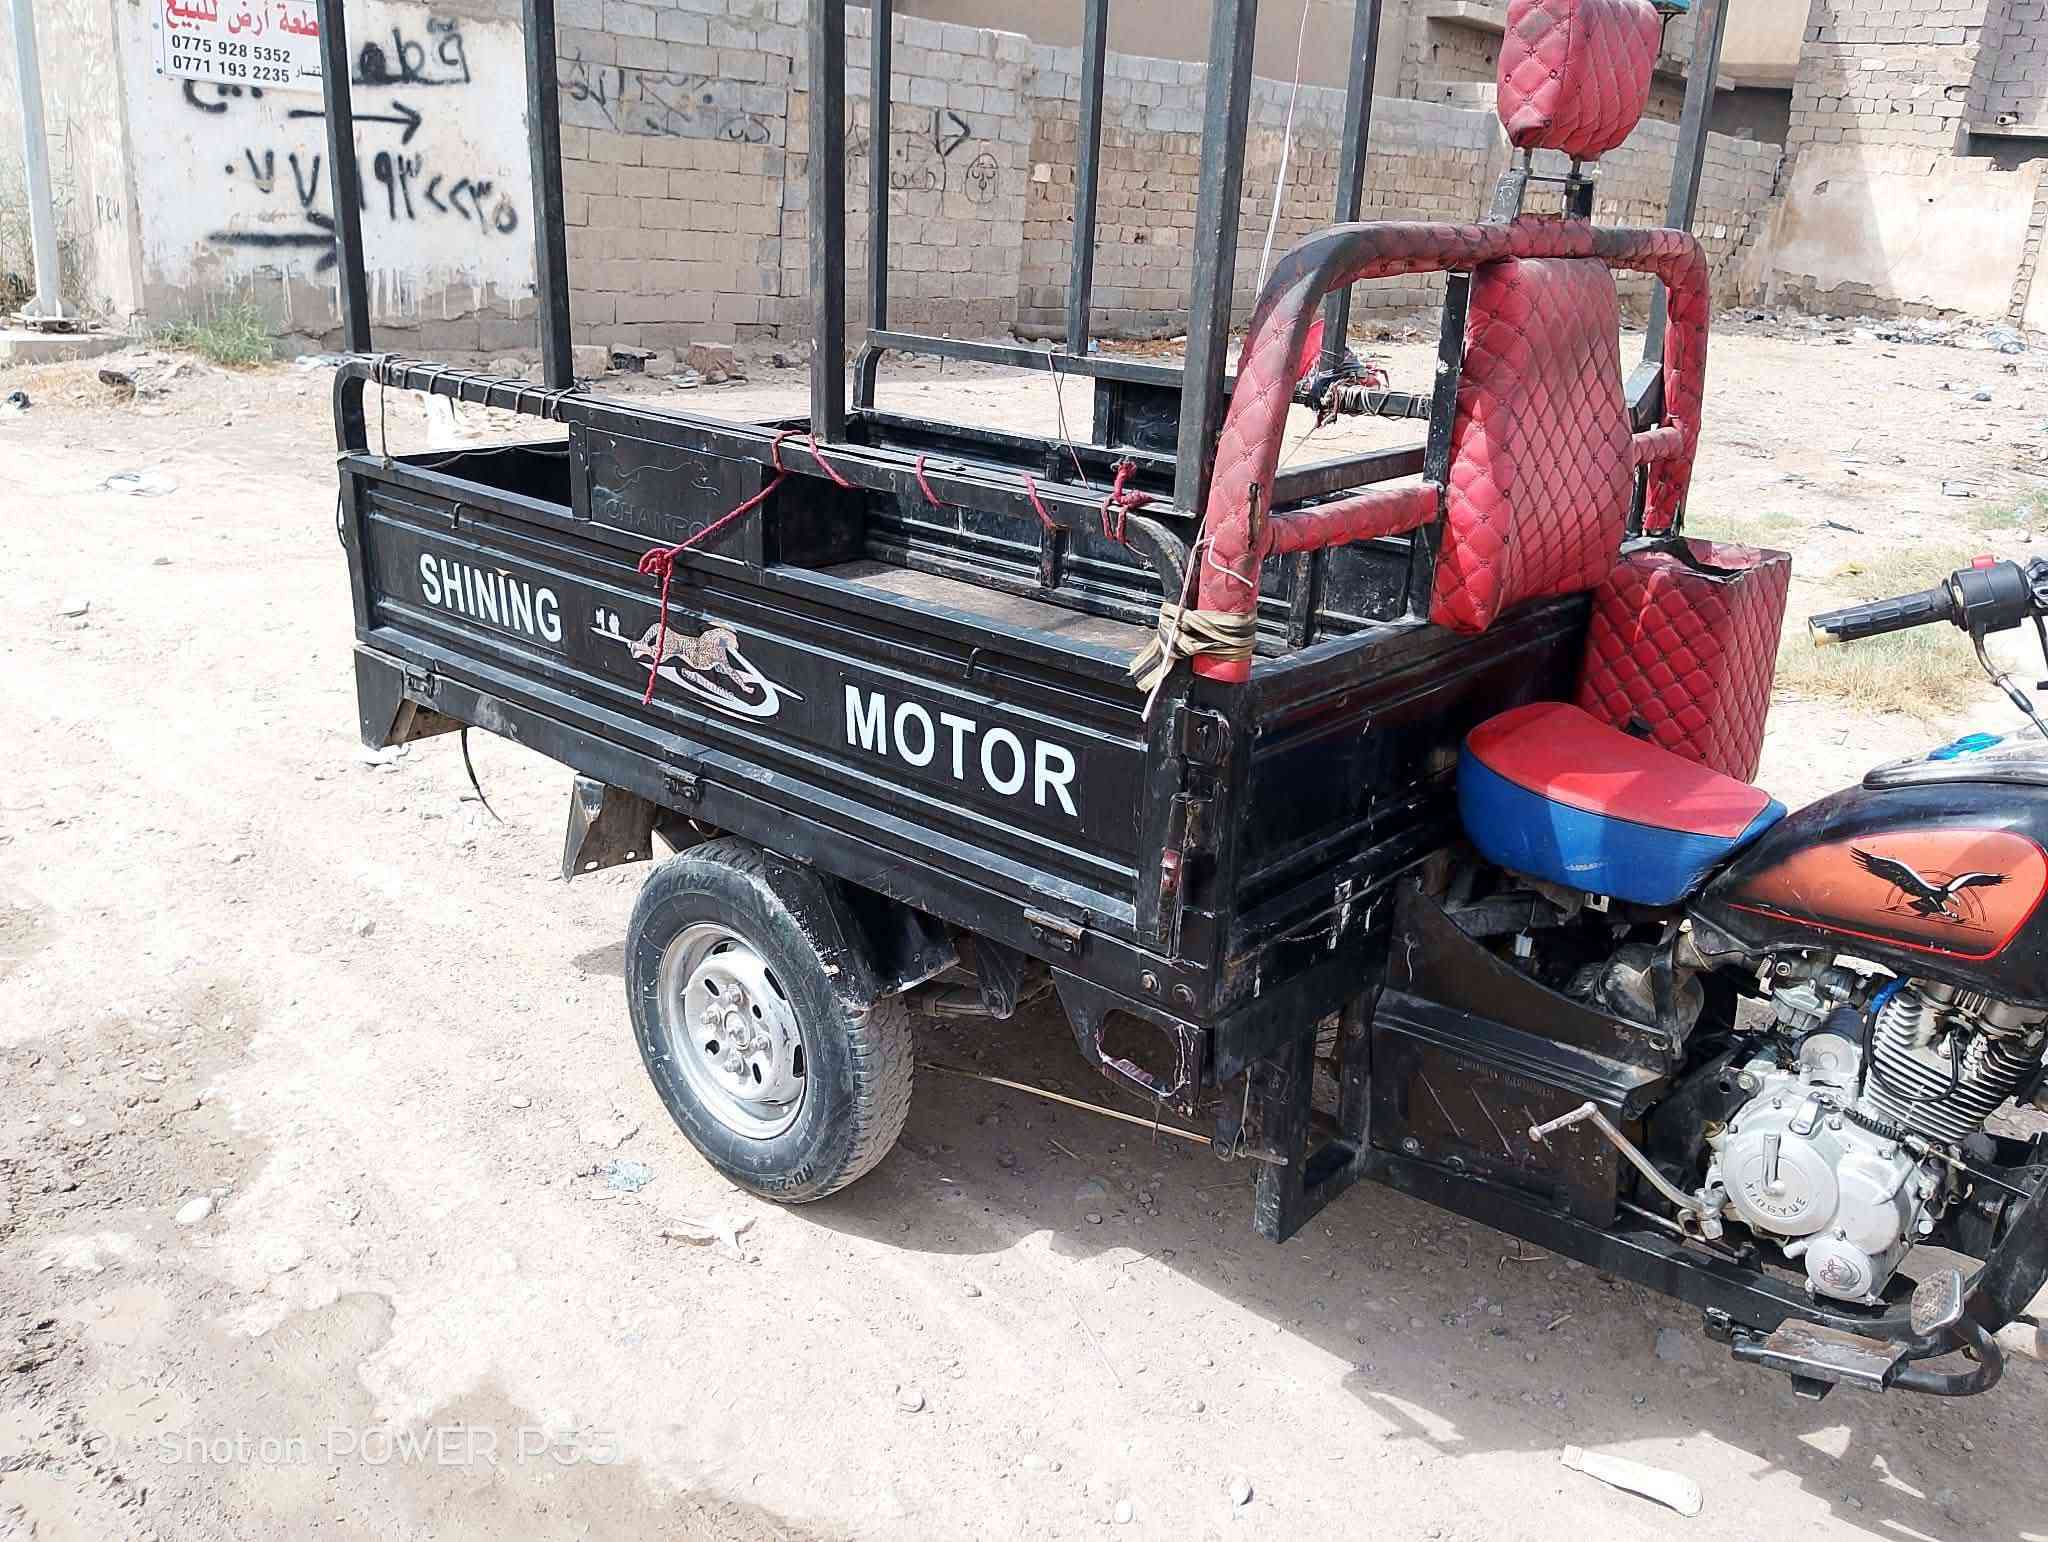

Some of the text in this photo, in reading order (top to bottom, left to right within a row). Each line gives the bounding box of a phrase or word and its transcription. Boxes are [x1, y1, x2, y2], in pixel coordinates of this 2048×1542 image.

[171, 34, 291, 64] 0775 928 5352
[172, 55, 211, 73] 0771
[218, 61, 247, 78] 193
[252, 65, 290, 83] 2235
[419, 553, 1078, 817] SHINING MOTOR
